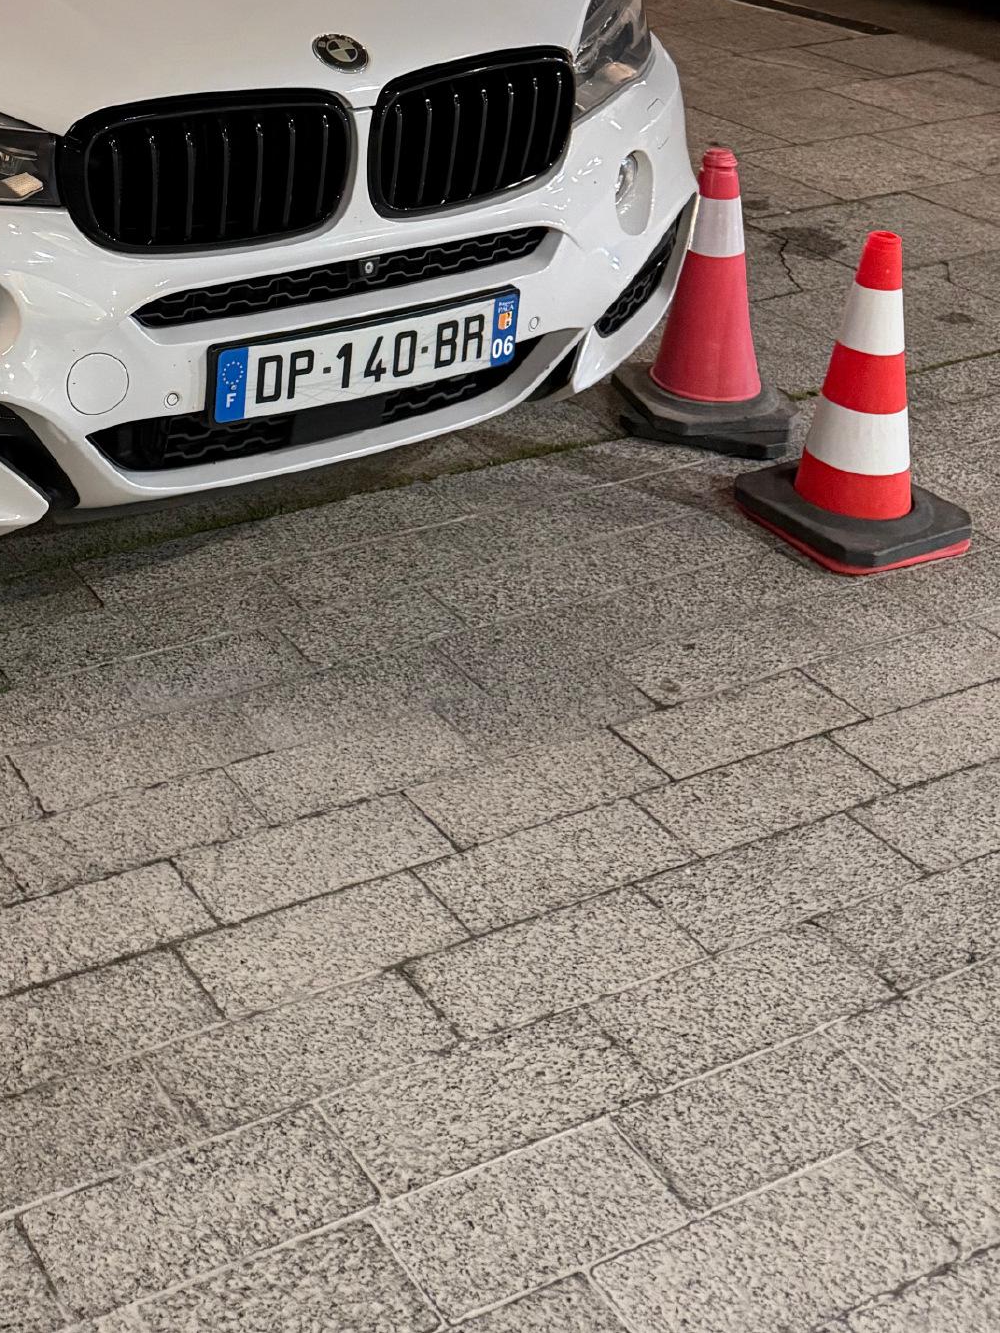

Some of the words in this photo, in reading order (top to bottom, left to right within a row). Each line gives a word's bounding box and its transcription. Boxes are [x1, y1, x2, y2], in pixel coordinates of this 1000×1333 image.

[492, 335, 514, 358] 06
[255, 313, 485, 404] DP-140-BR
[225, 392, 237, 408] F
